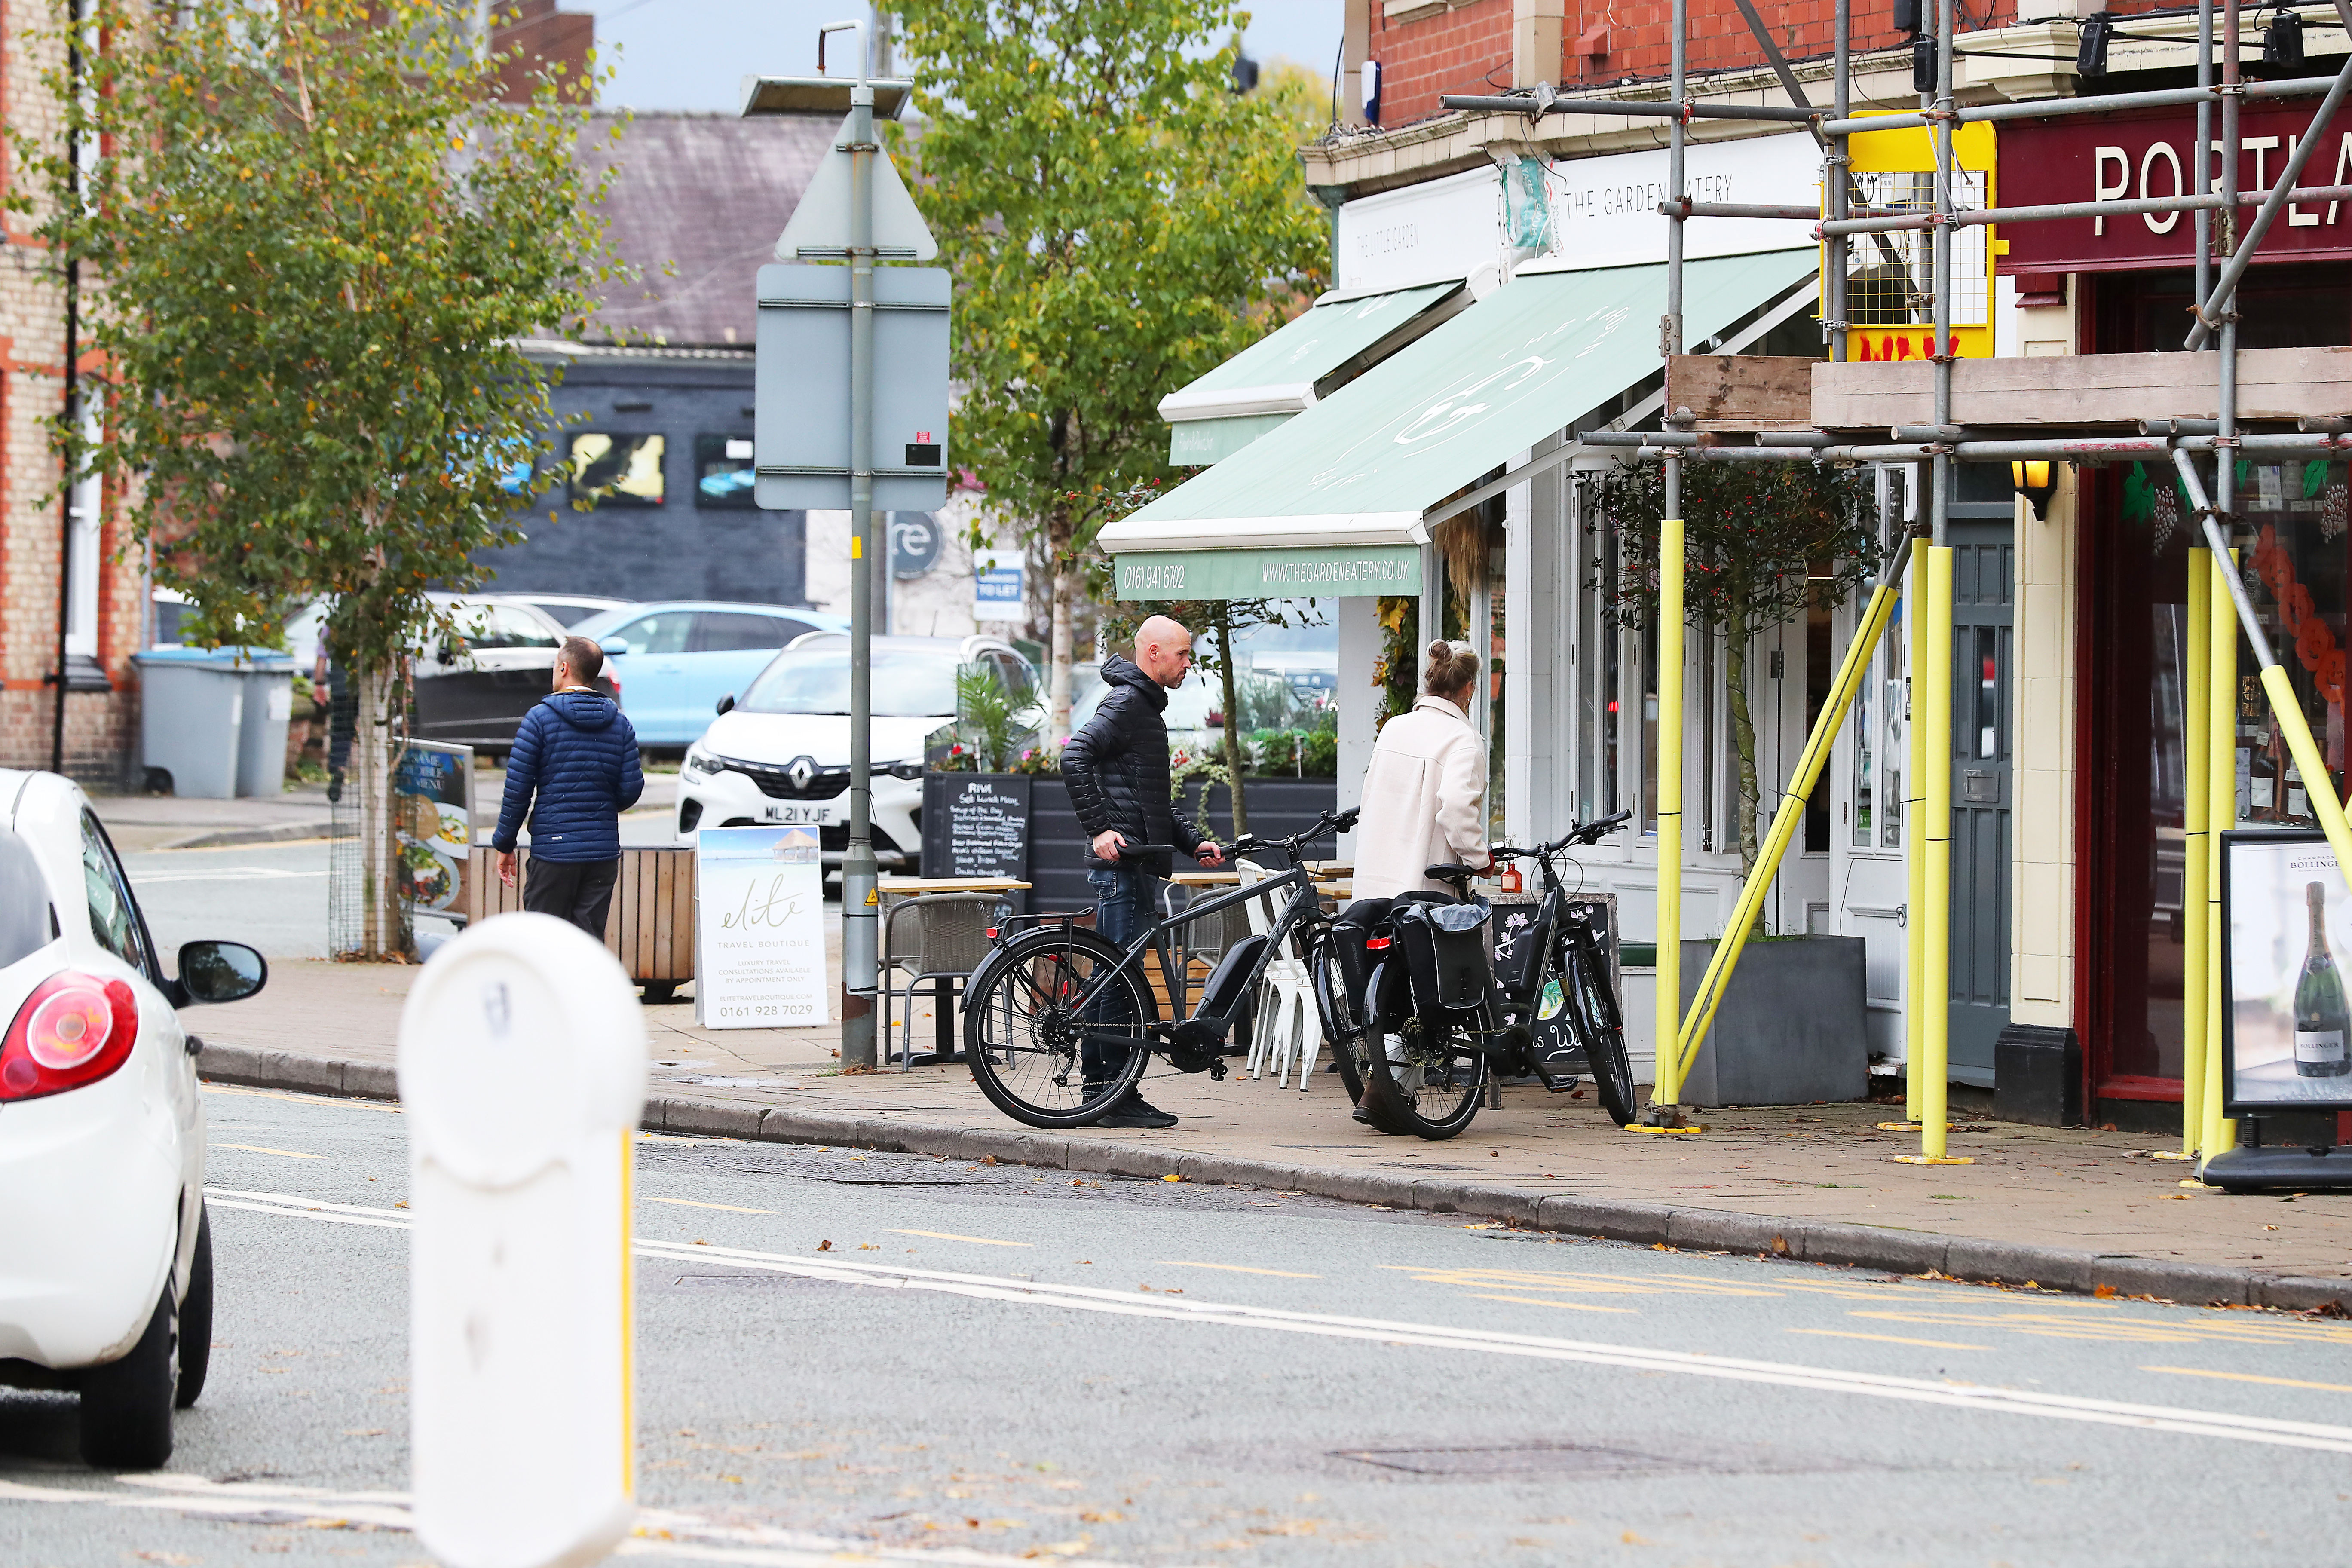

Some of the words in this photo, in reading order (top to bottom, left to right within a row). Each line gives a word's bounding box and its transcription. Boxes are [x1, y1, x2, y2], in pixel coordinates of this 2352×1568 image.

[1564, 190, 1594, 219] THE
[1604, 182, 1666, 215] GARDEN
[1685, 174, 1733, 203] ATERY
[1393, 223, 1418, 251] GARDEN
[1124, 565, 1144, 589] 0161
[1146, 565, 1161, 589] 941
[1163, 564, 1185, 589] 6702
[1262, 560, 1409, 582] WWW.THEGARDENEATERY.CO.UK
[803, 808, 830, 821] YJF
[2290, 860, 2340, 868] BOLLINGE
[721, 873, 805, 931] elite
[719, 993, 812, 1002] ELITETRAVELBOUTIQUE.COM
[720, 1006, 750, 1017] 0161
[755, 1006, 778, 1016] 928
[783, 1005, 813, 1015] 7029
